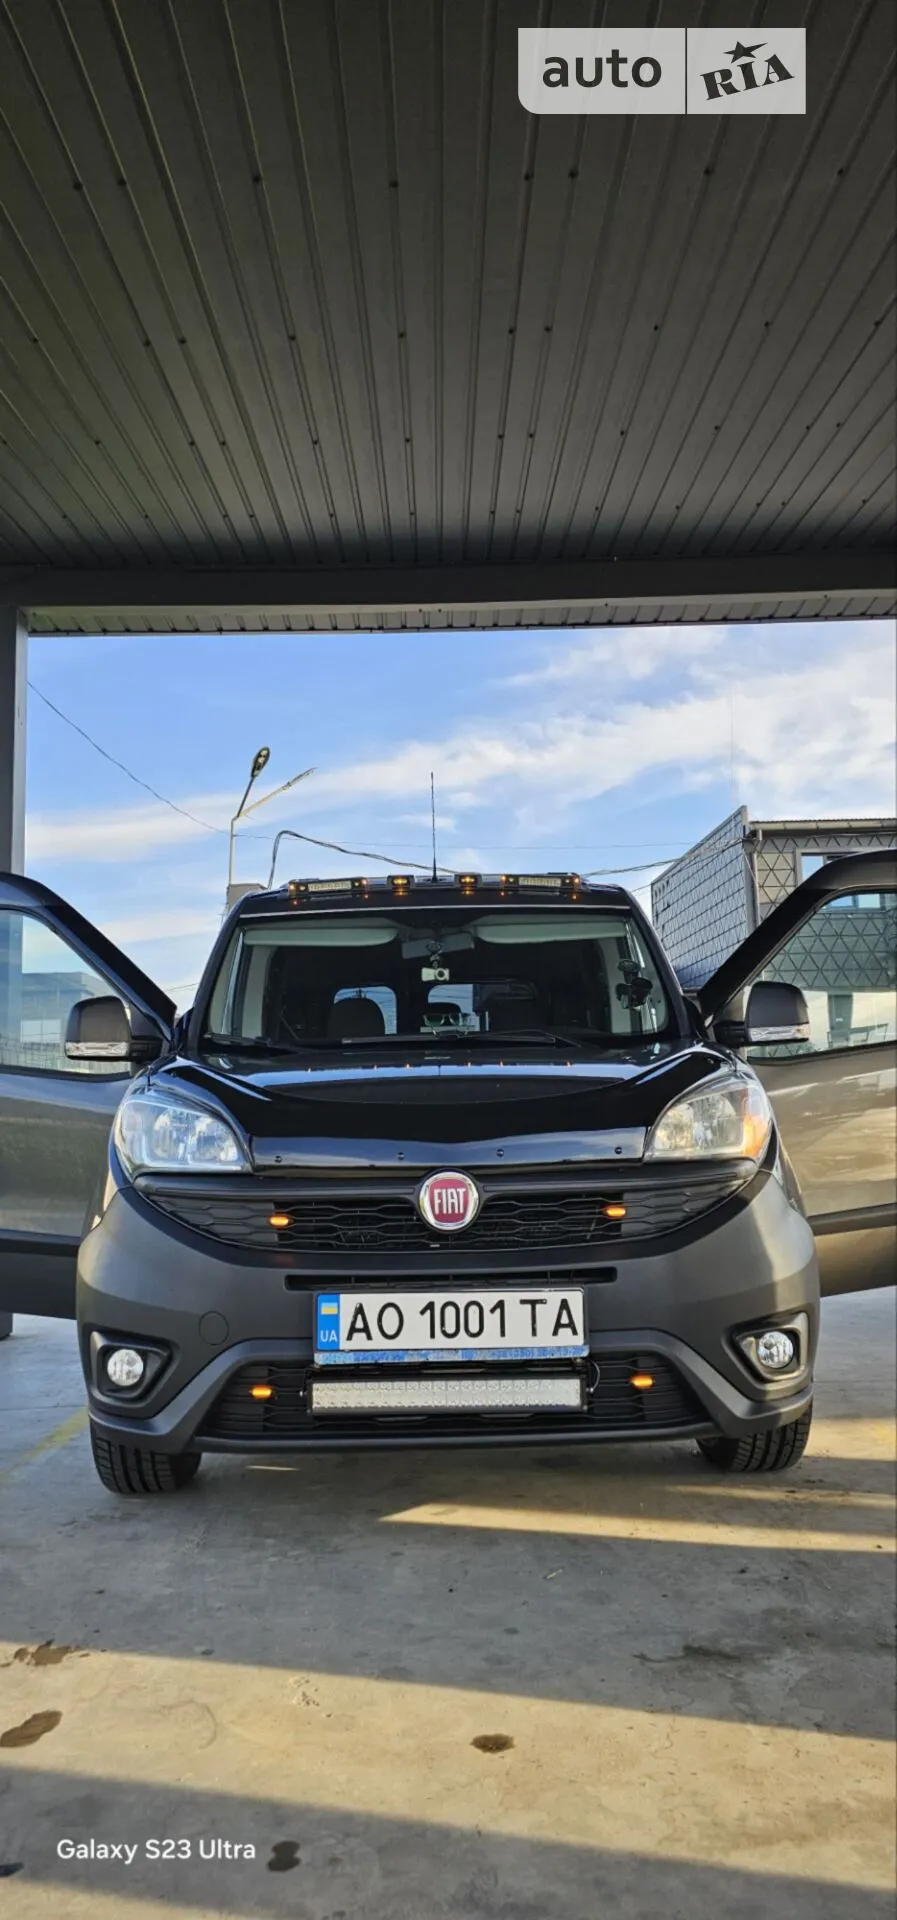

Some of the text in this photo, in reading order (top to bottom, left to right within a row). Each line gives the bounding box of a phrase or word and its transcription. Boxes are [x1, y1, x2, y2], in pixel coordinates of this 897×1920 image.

[433, 1187, 467, 1215] FIAT
[346, 1298, 579, 1341] AO 1001 TA
[320, 1329, 338, 1343] UA
